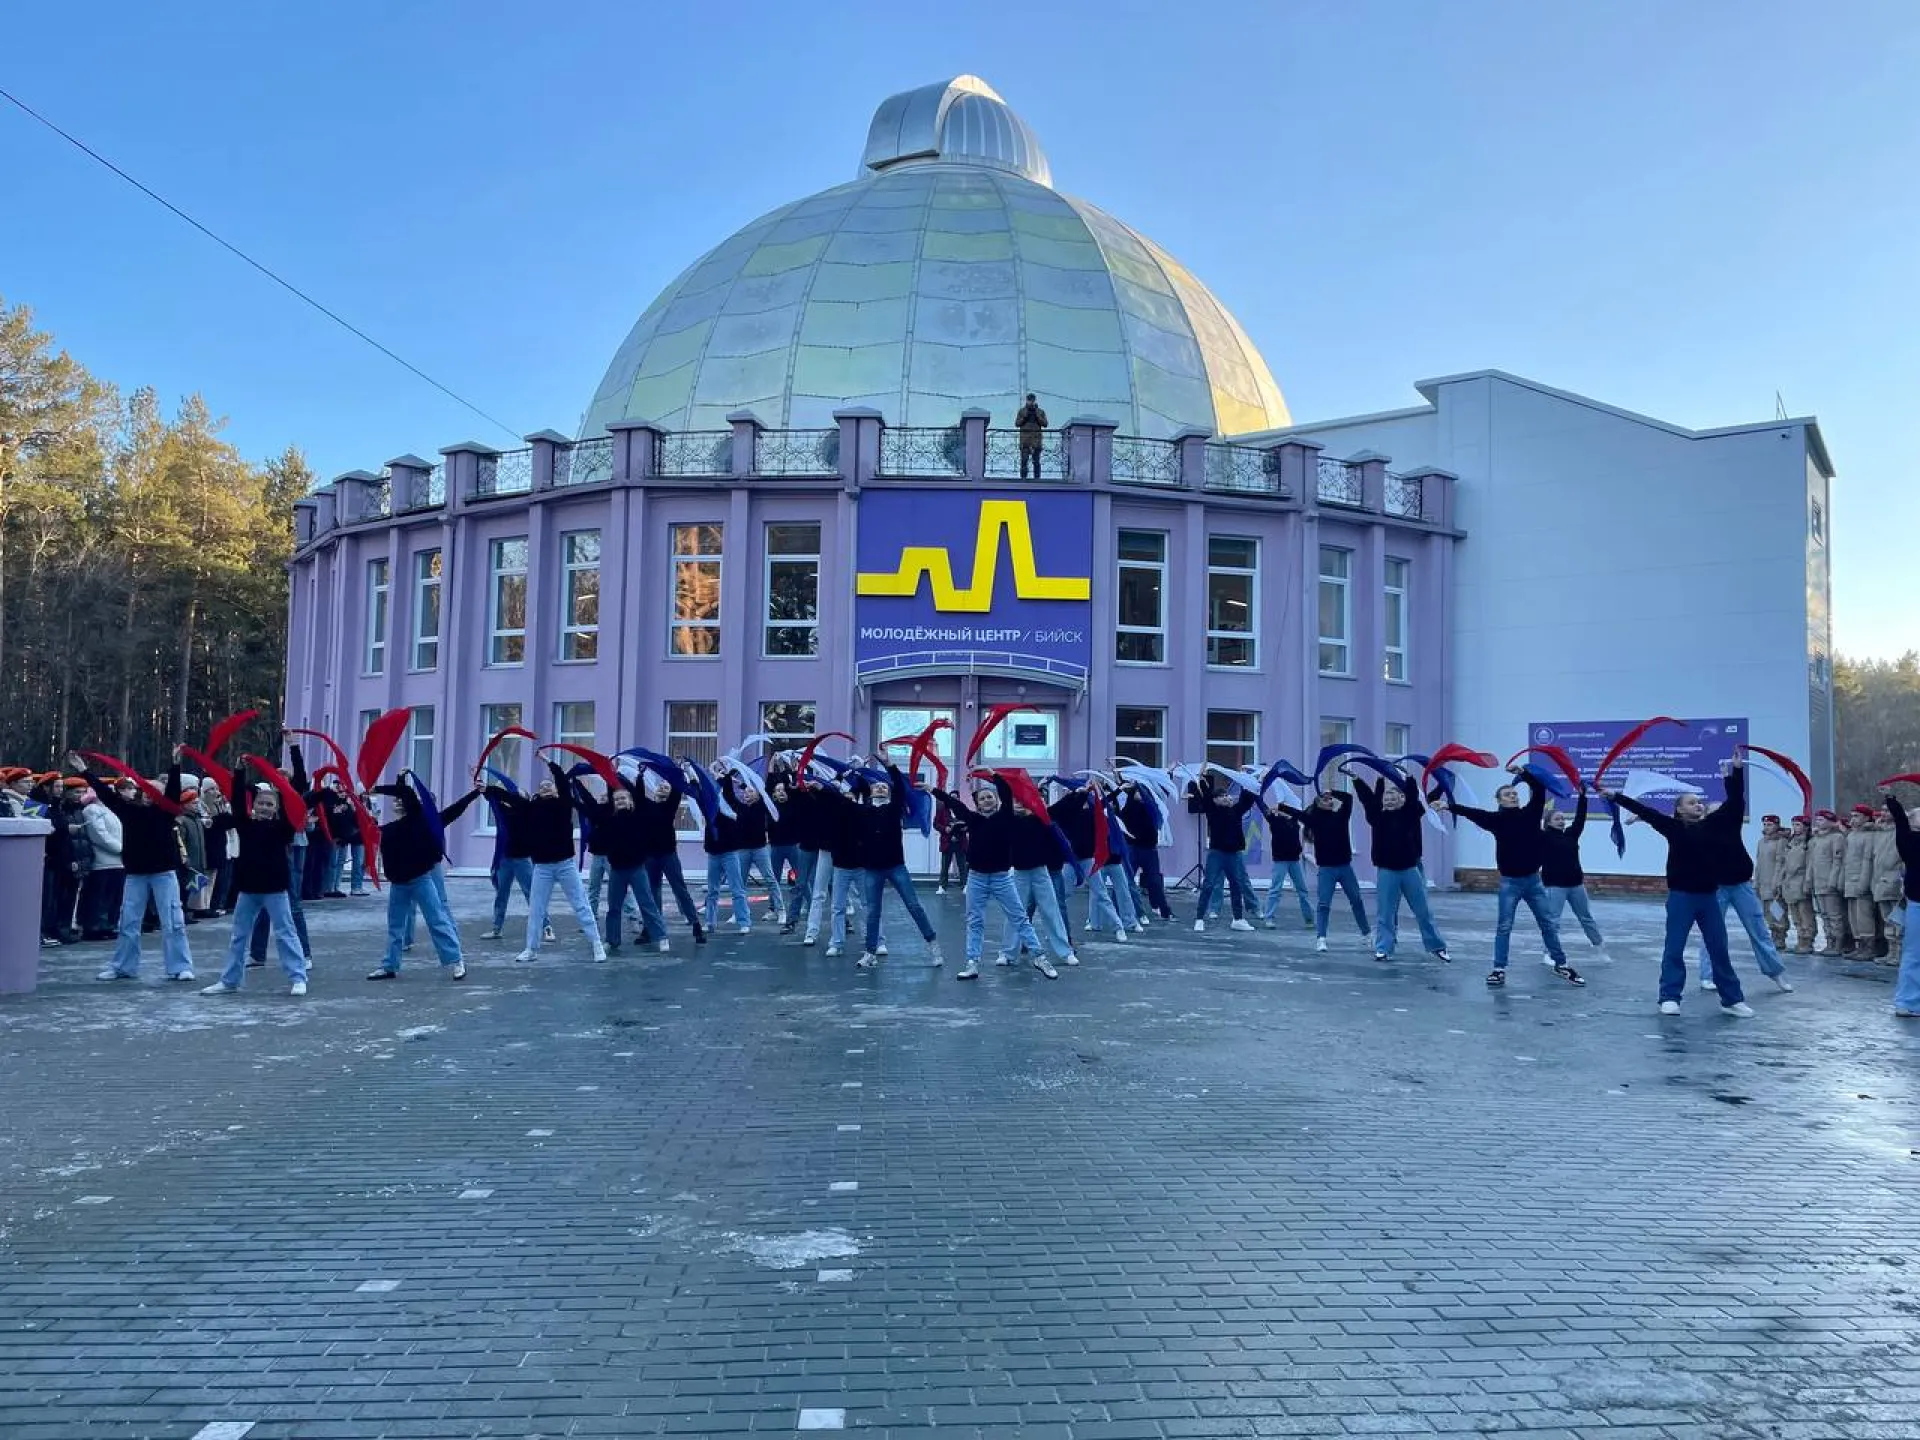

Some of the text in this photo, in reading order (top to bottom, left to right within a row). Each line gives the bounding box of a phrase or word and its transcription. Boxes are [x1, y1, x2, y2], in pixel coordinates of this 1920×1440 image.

[860, 625, 971, 641] МОЛОДЁЖНЫЙ
[976, 629, 1021, 642] ЦЕНТР
[1035, 628, 1083, 643] БИЙСК
